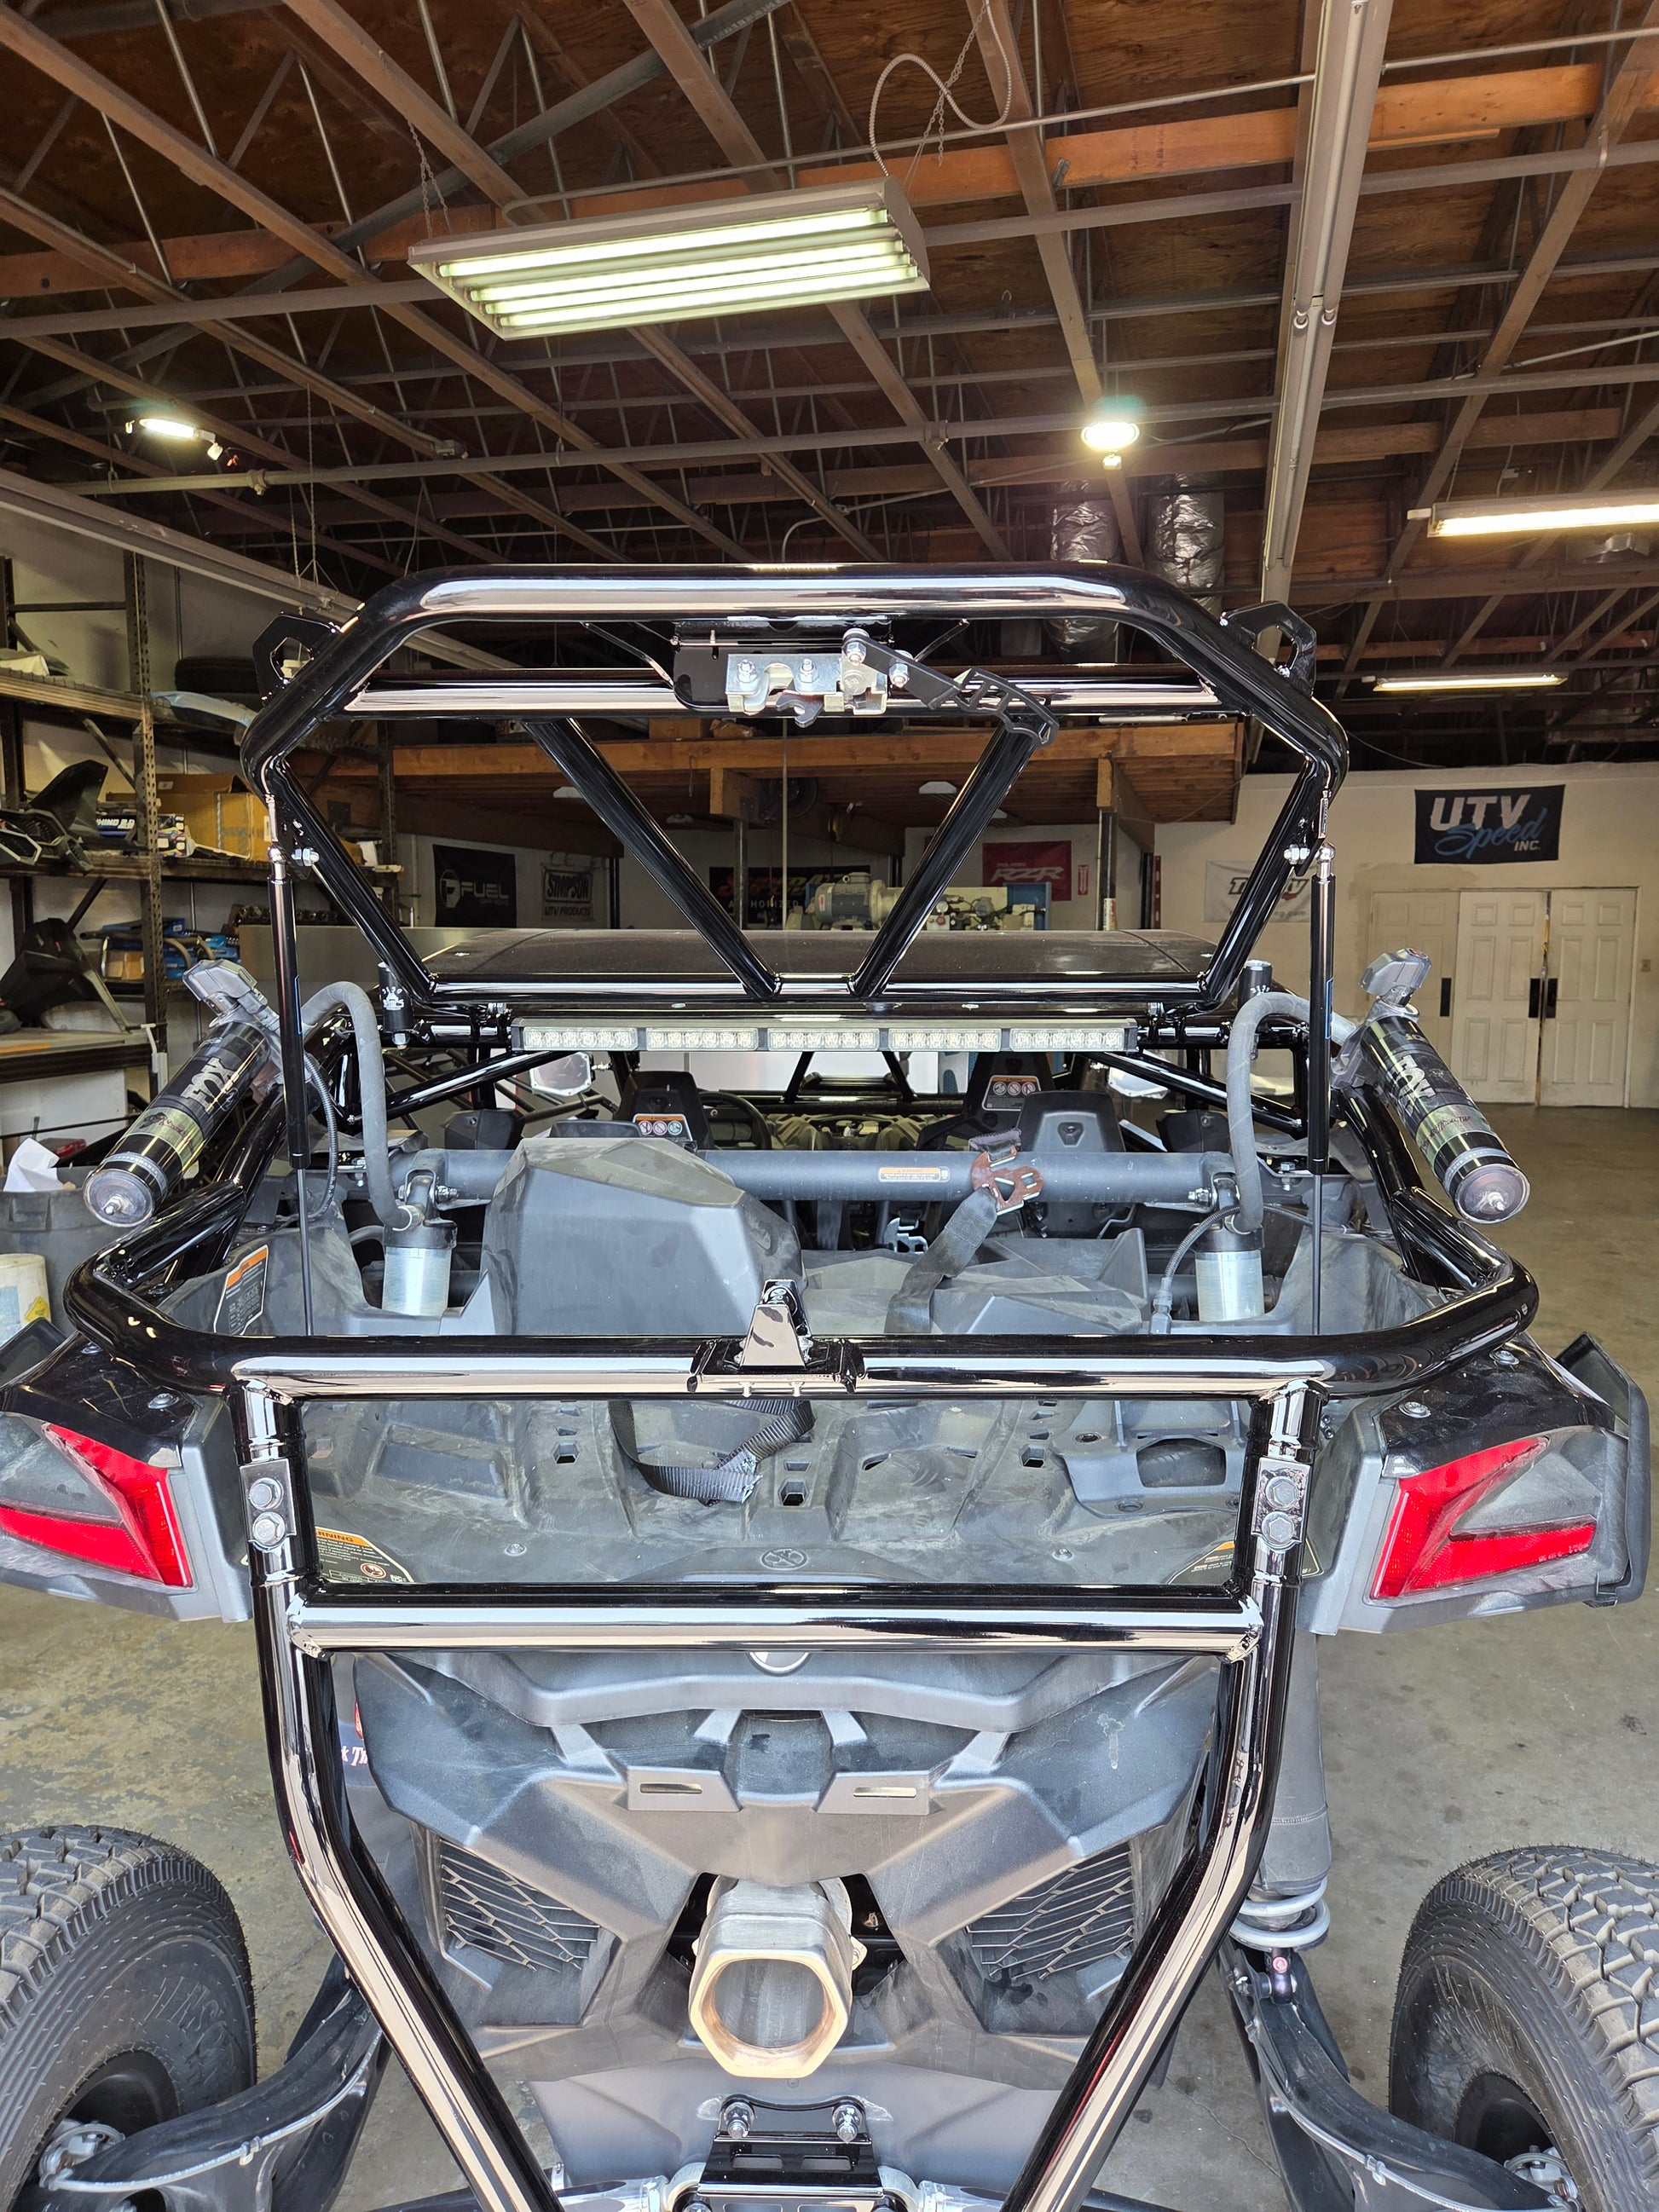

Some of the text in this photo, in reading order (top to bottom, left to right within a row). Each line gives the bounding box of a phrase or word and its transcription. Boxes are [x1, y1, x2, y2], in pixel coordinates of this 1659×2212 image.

[1430, 794, 1531, 831] UTV
[1435, 807, 1548, 859] Speed
[546, 874, 589, 900] SIMPSON
[991, 866, 1065, 883] RZR
[461, 881, 509, 899] FUEL
[544, 905, 591, 917] UTV PRODUCTS
[180, 1057, 235, 1113] FOX
[1384, 1054, 1436, 1117] FOX
[318, 1531, 354, 1542] RNING
